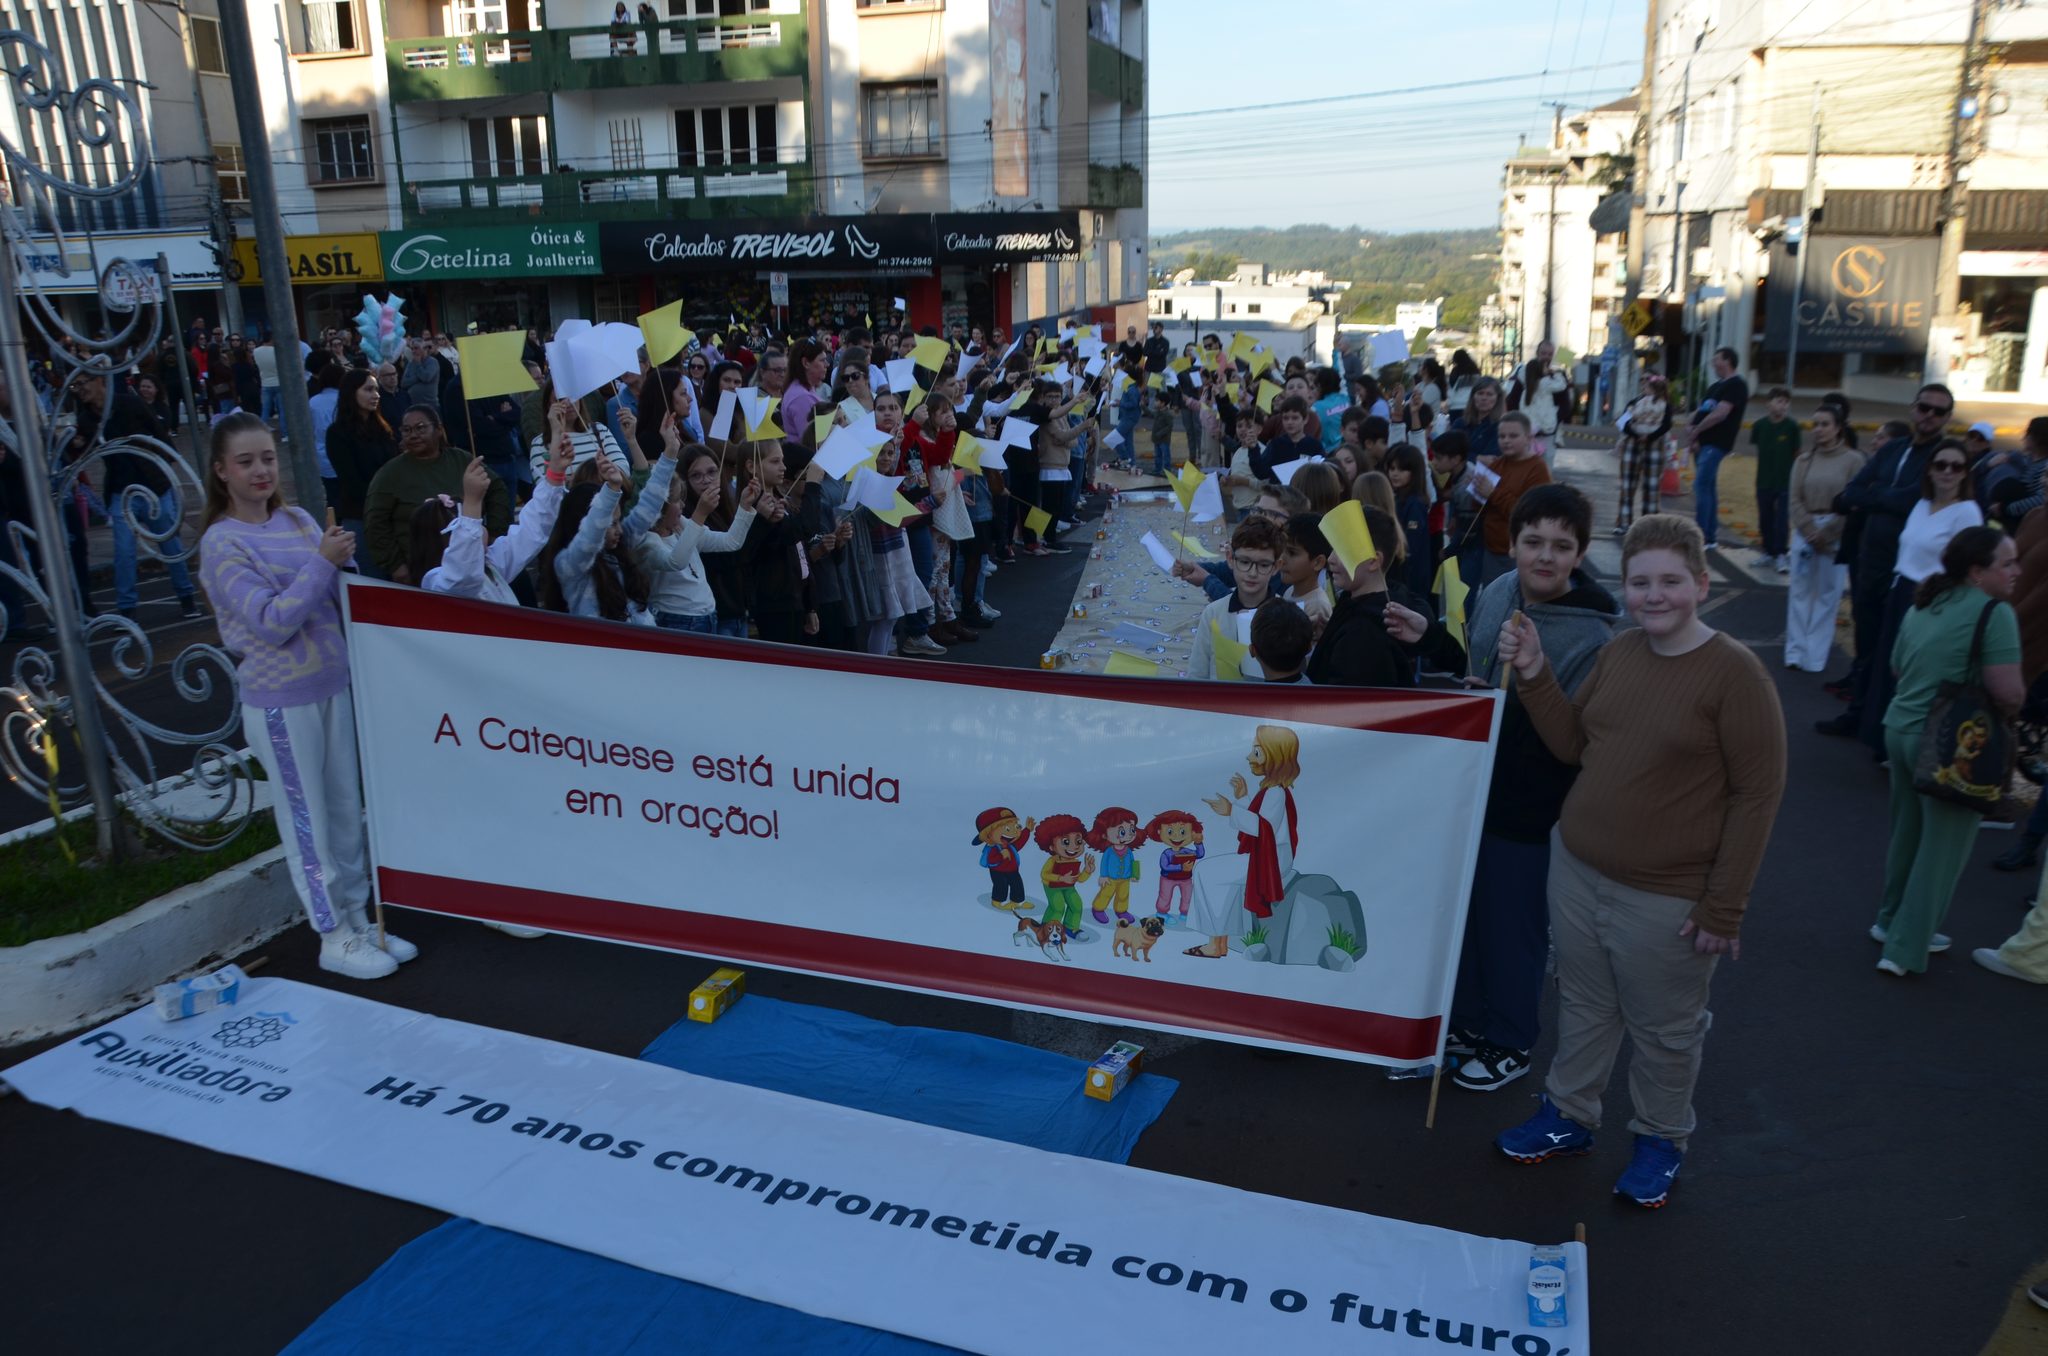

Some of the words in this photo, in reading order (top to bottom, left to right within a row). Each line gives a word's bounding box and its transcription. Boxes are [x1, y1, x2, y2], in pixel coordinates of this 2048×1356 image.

[530, 226, 570, 245] Ótica
[574, 230, 586, 244] &
[645, 232, 727, 262] Calçados
[730, 230, 835, 259] TREVISOL
[944, 232, 993, 251] Calçados
[994, 232, 1053, 251] TREVISOL
[526, 250, 595, 268] Joalheria
[1798, 300, 1924, 328] CASTIE
[433, 712, 462, 747] A
[478, 717, 675, 773] Catequese
[692, 754, 774, 787] está
[793, 763, 901, 804] unida
[566, 789, 623, 818] em
[641, 798, 780, 840] oração!
[80, 1030, 293, 1103] Auxiliadora
[364, 1075, 444, 1108] Há
[444, 1094, 510, 1124] 70
[511, 1112, 645, 1160] anos
[652, 1146, 1094, 1268] comprometida
[1111, 1255, 1249, 1303] com
[1269, 1288, 1308, 1313] o
